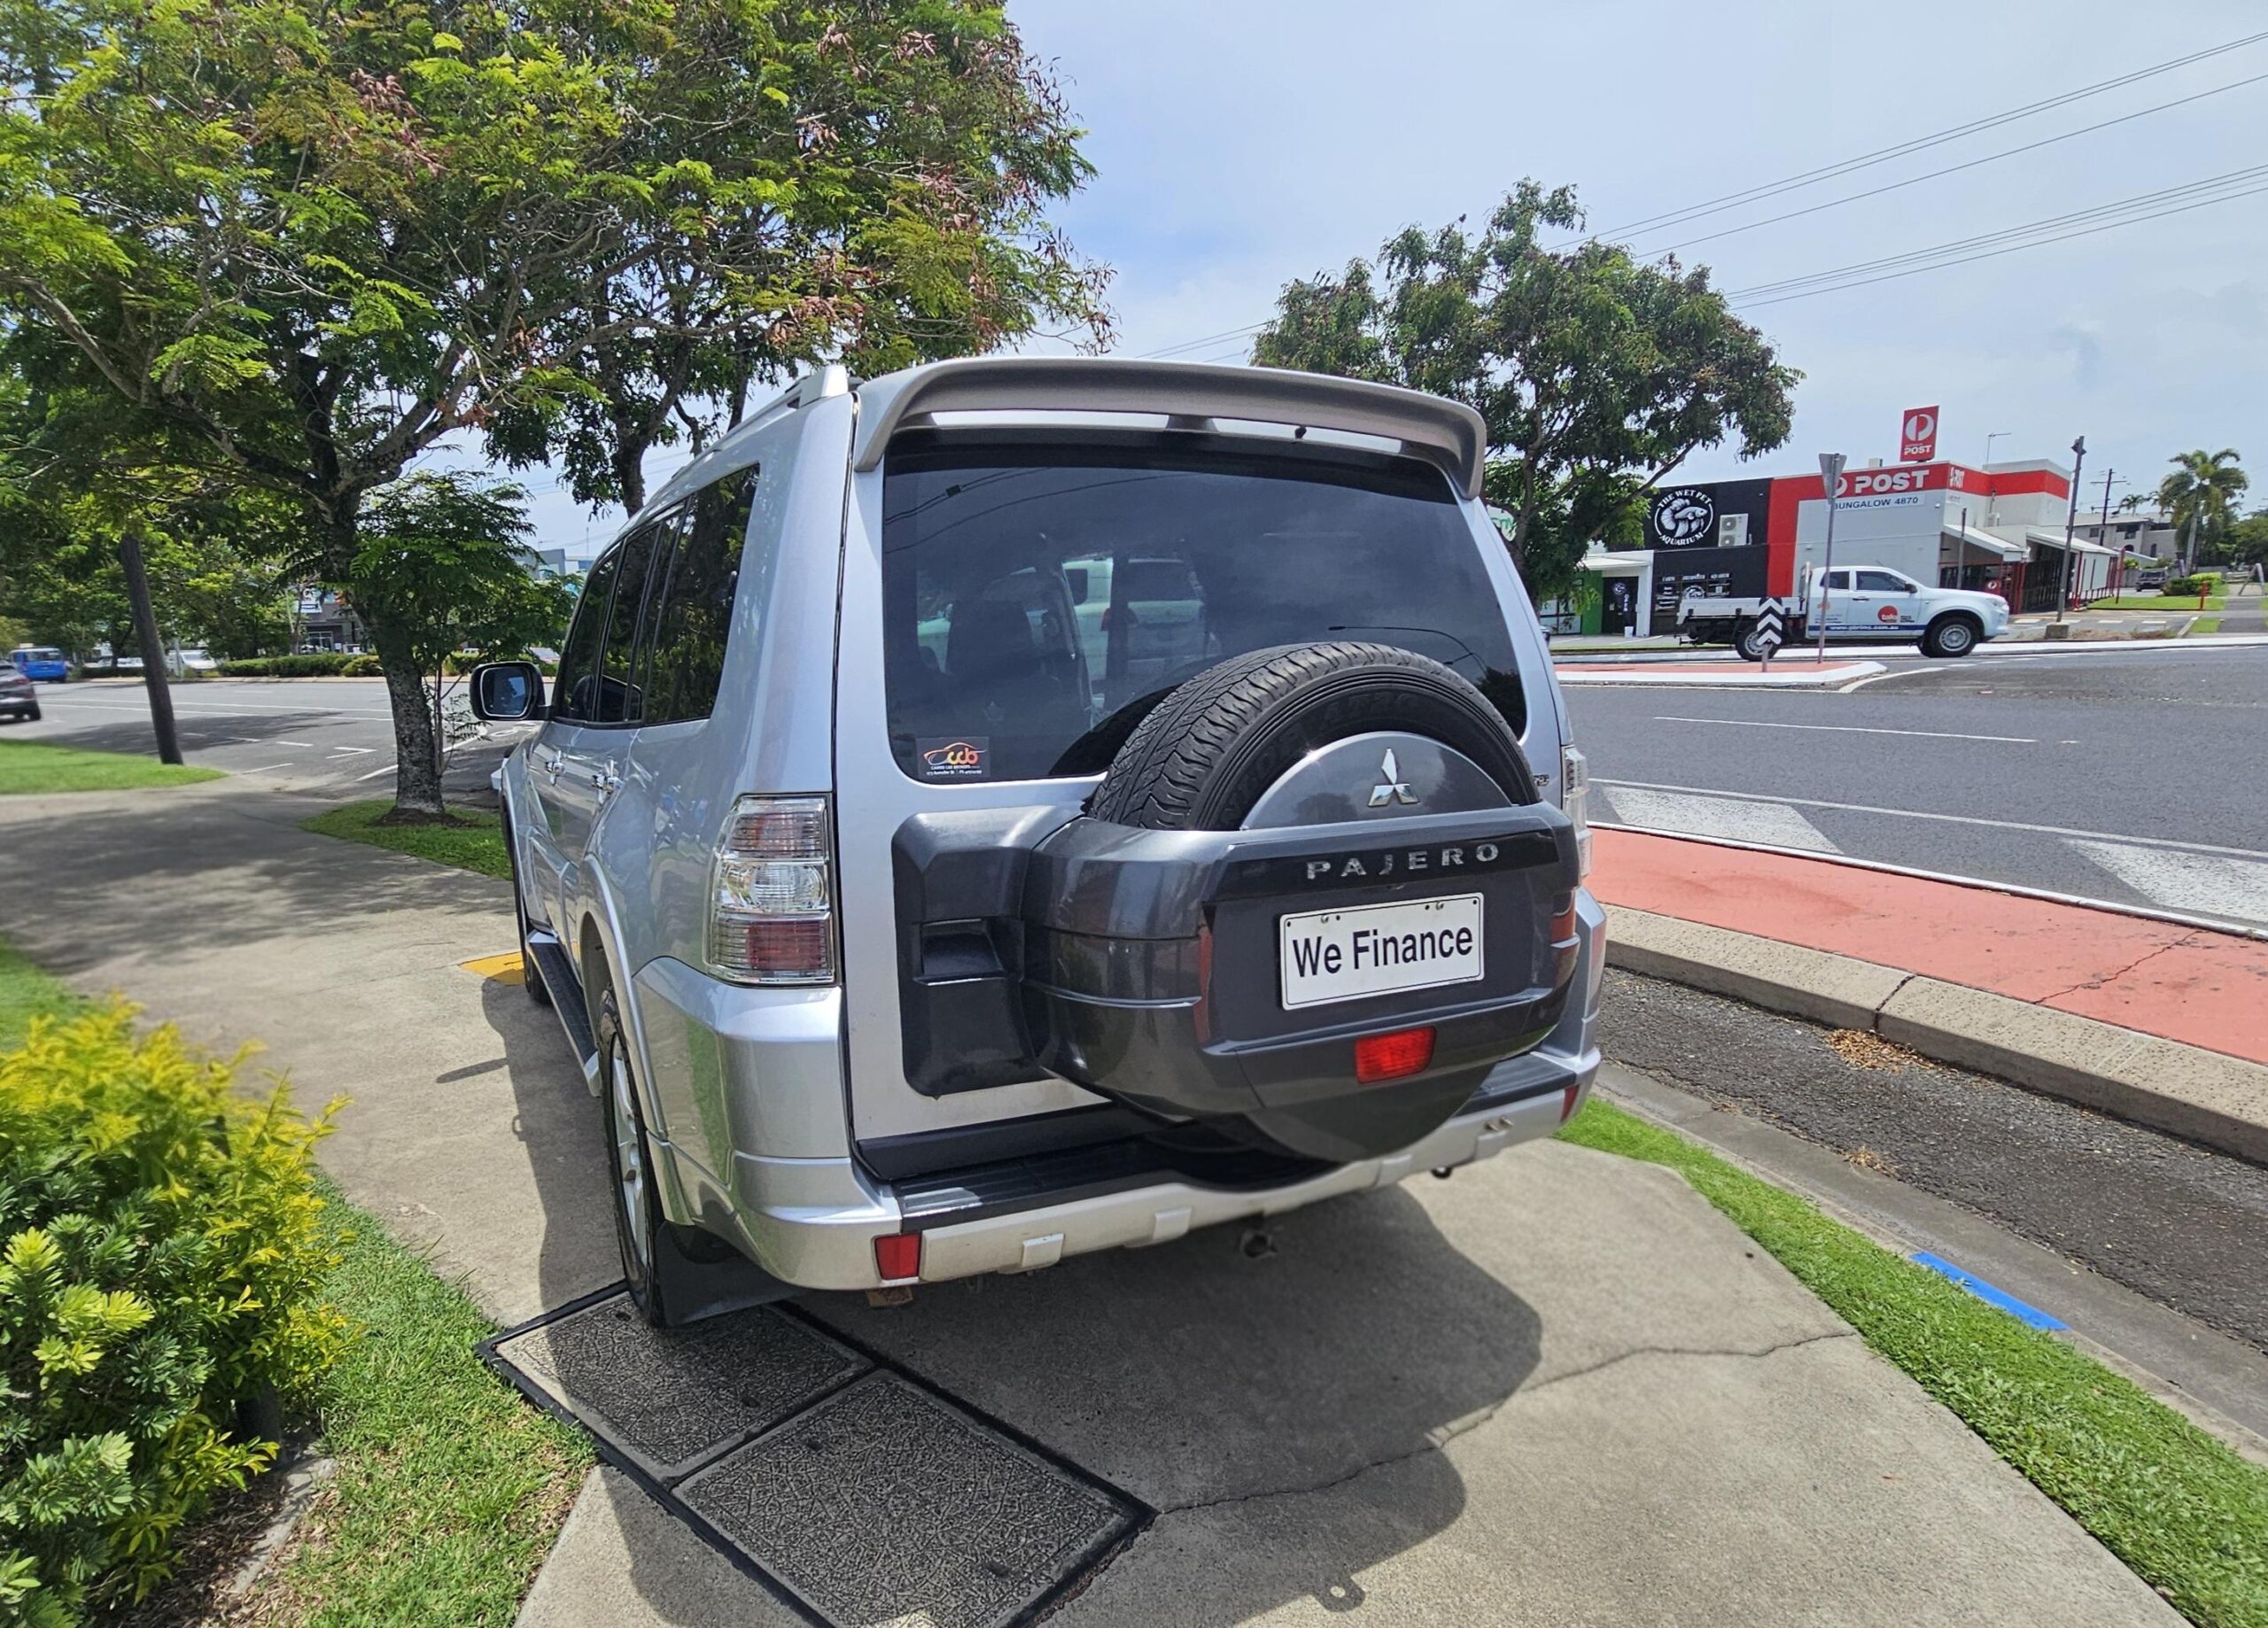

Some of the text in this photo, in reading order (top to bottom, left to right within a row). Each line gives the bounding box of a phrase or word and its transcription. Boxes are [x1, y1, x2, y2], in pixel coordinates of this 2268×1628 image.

[1904, 445, 1931, 455] POST
[1854, 469, 1930, 494] POST
[1658, 493, 1675, 508] THE
[1696, 492, 1713, 505] PET
[1894, 496, 1919, 505] 4870
[1659, 531, 1704, 546] AQUARIUM
[1306, 843, 1500, 880] PAJERO
[1293, 926, 1473, 977] We Finance
